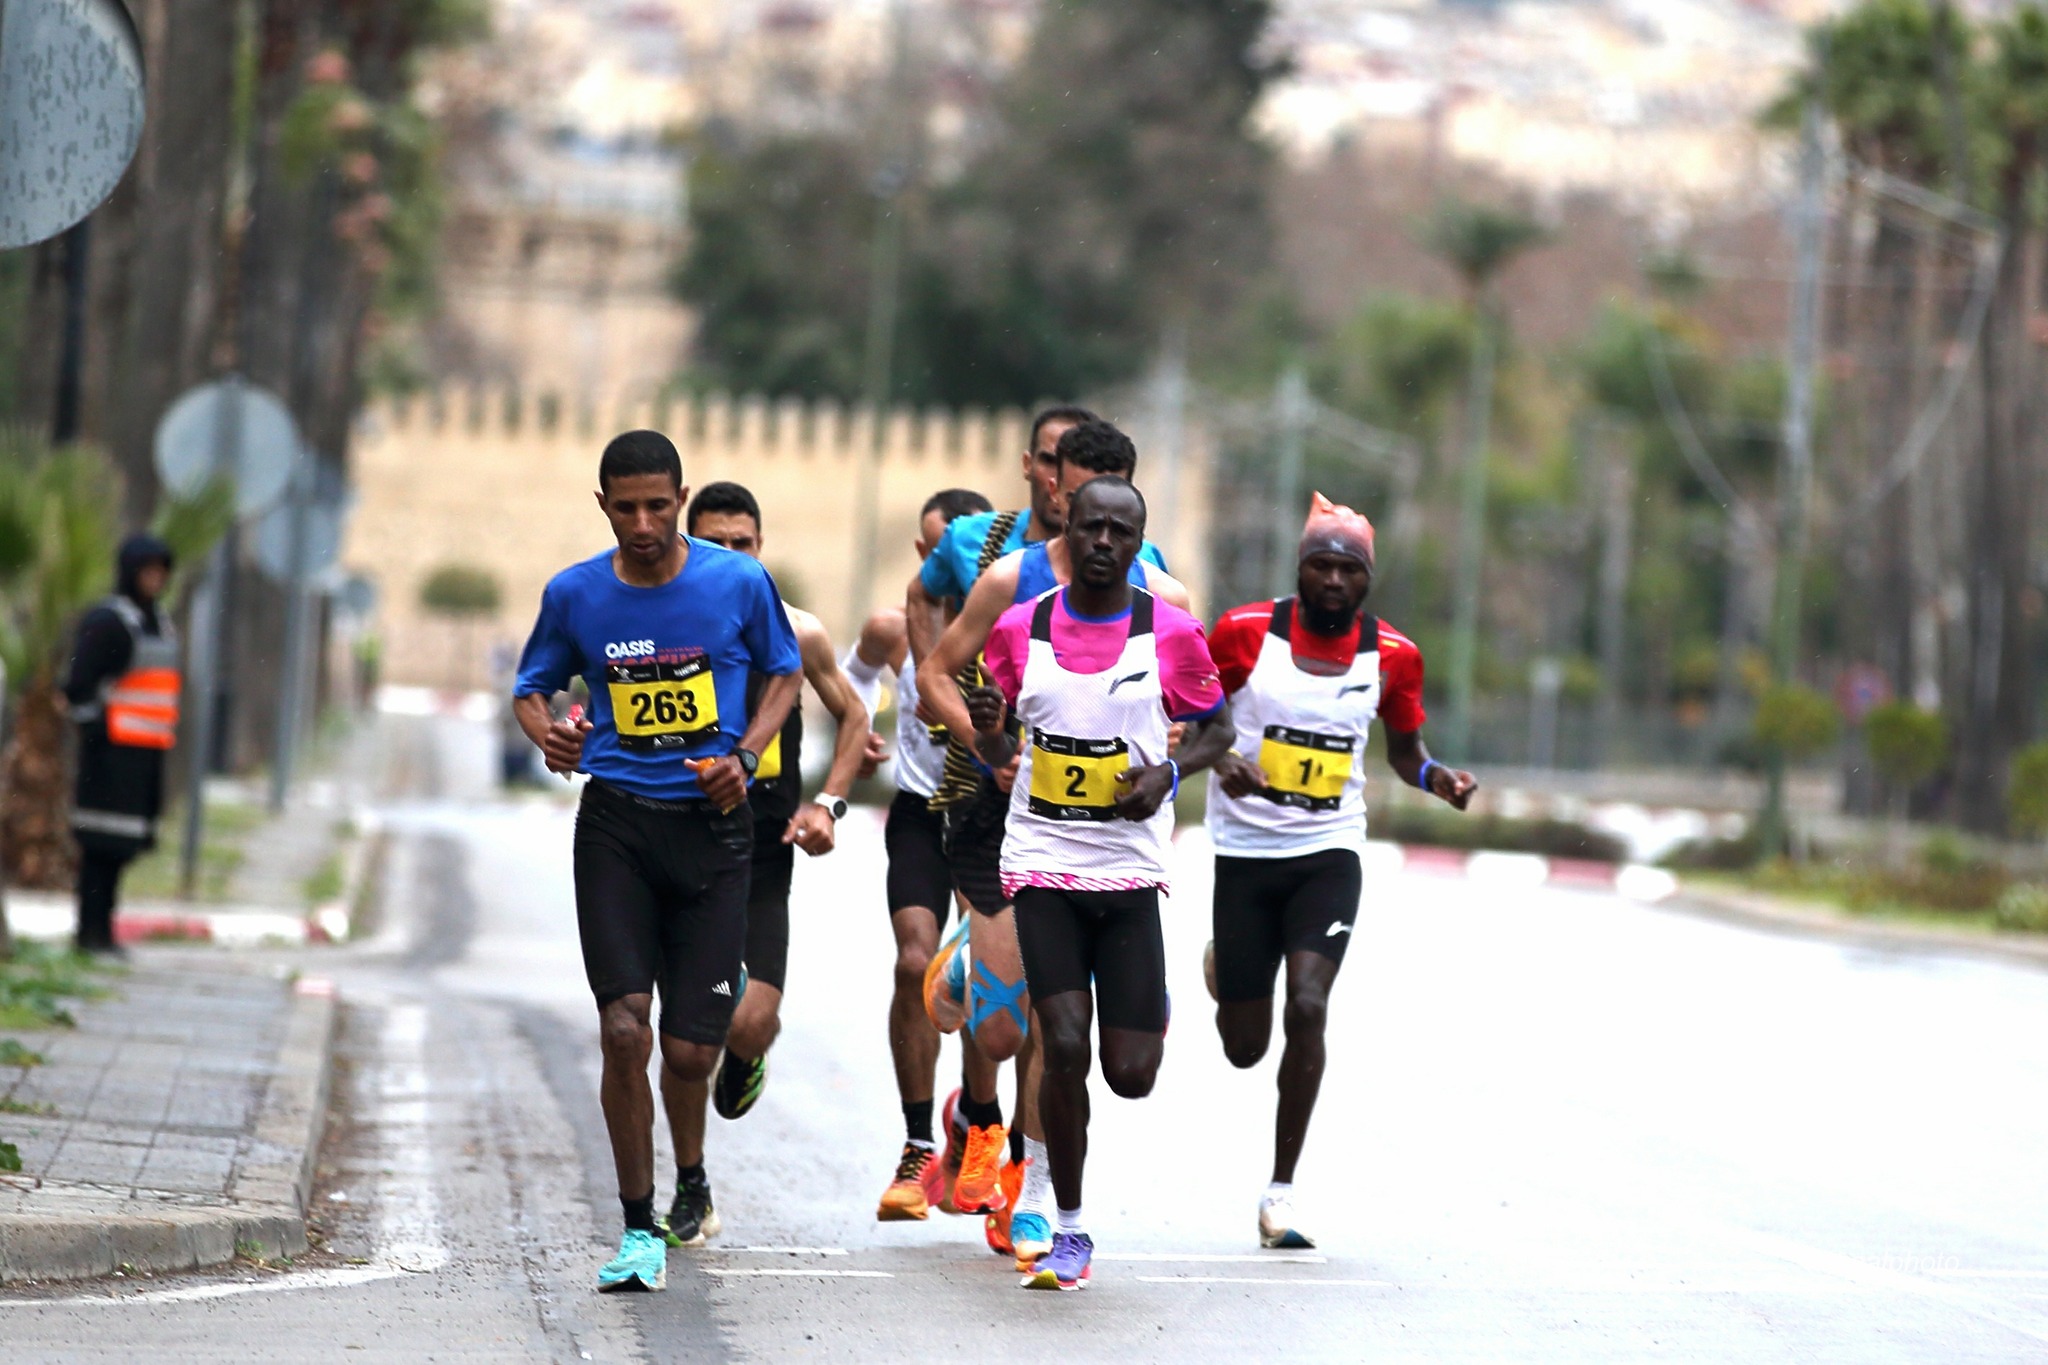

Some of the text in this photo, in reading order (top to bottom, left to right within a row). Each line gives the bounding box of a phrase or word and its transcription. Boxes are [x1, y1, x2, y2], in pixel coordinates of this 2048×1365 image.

[604, 639, 656, 659] OASIS
[630, 689, 699, 727] 263
[1064, 765, 1088, 797] 2
